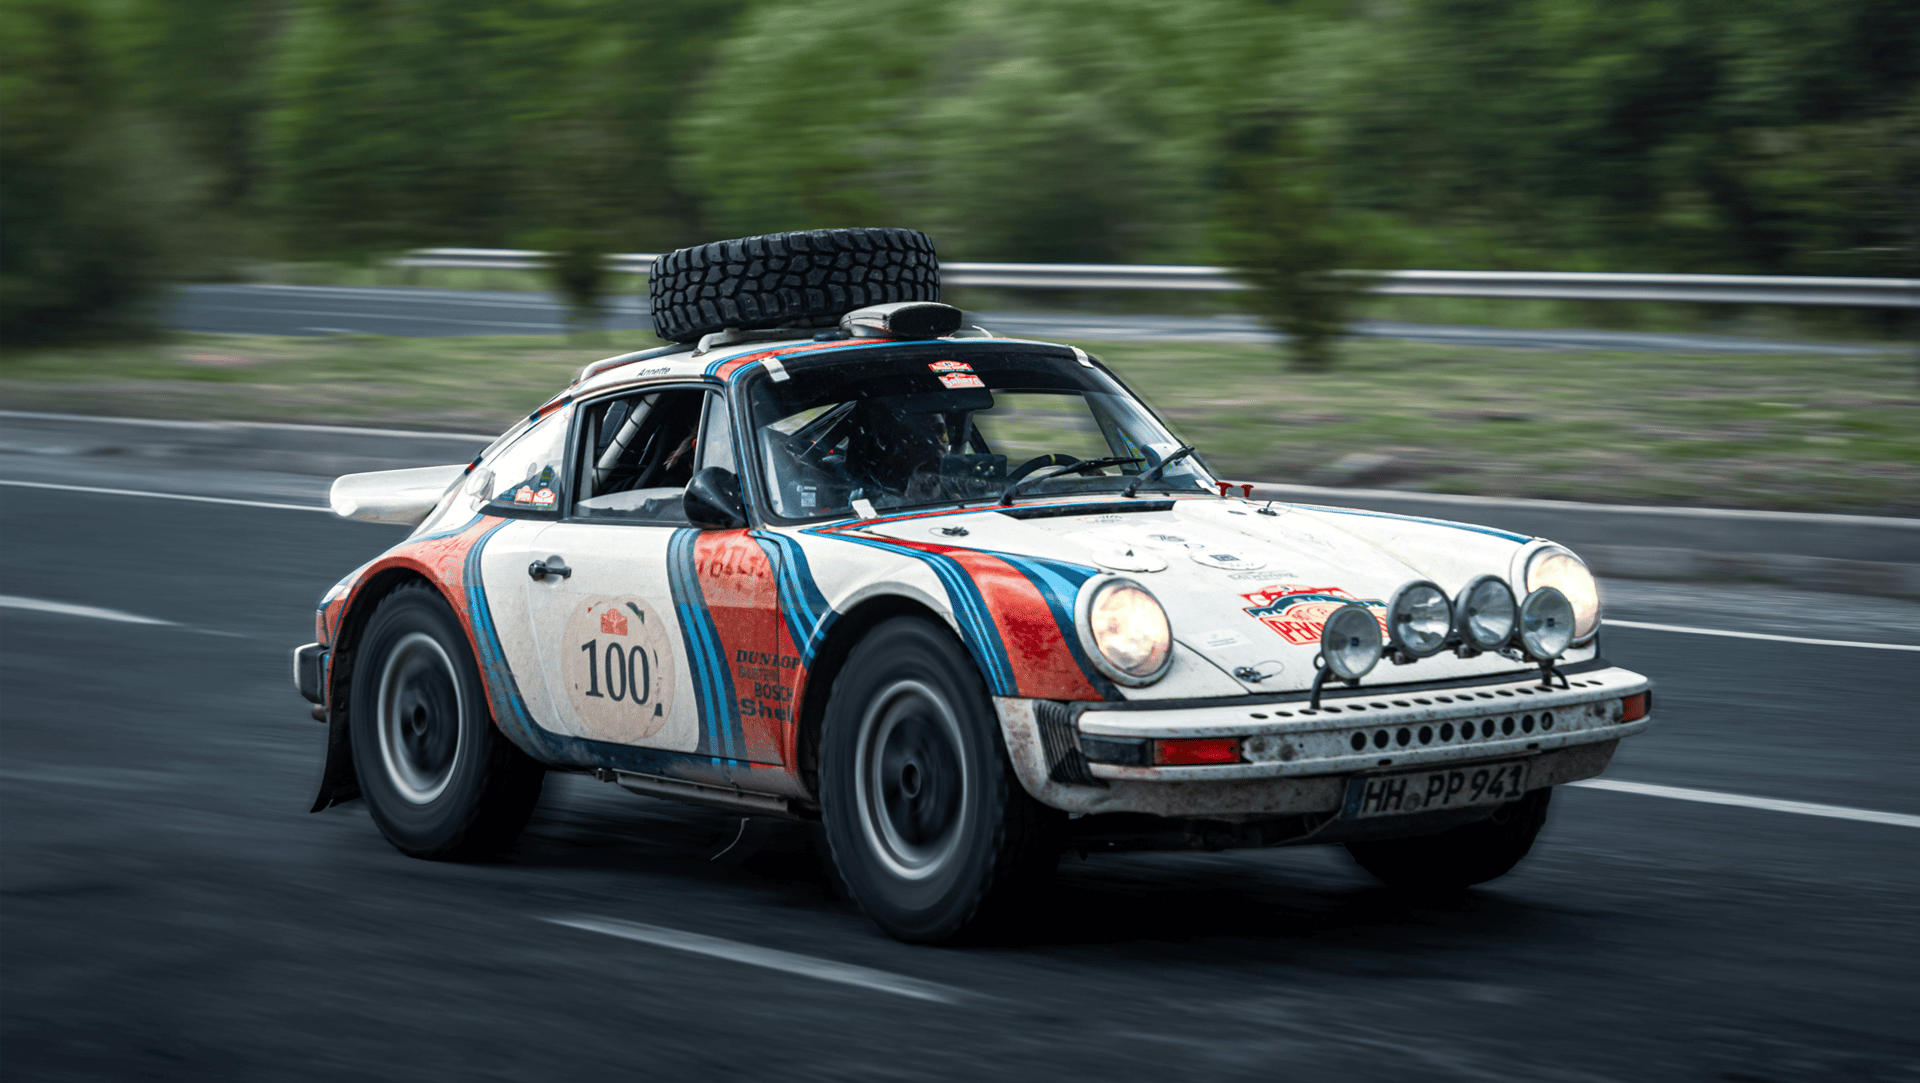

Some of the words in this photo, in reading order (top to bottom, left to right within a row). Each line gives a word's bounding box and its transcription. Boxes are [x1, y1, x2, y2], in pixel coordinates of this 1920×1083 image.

[636, 366, 671, 377] Annette
[581, 638, 650, 706] 100
[735, 649, 801, 670] DUNLOP
[1362, 778, 1408, 813] HH
[1424, 771, 1466, 807] PP
[1470, 765, 1523, 801] 941
